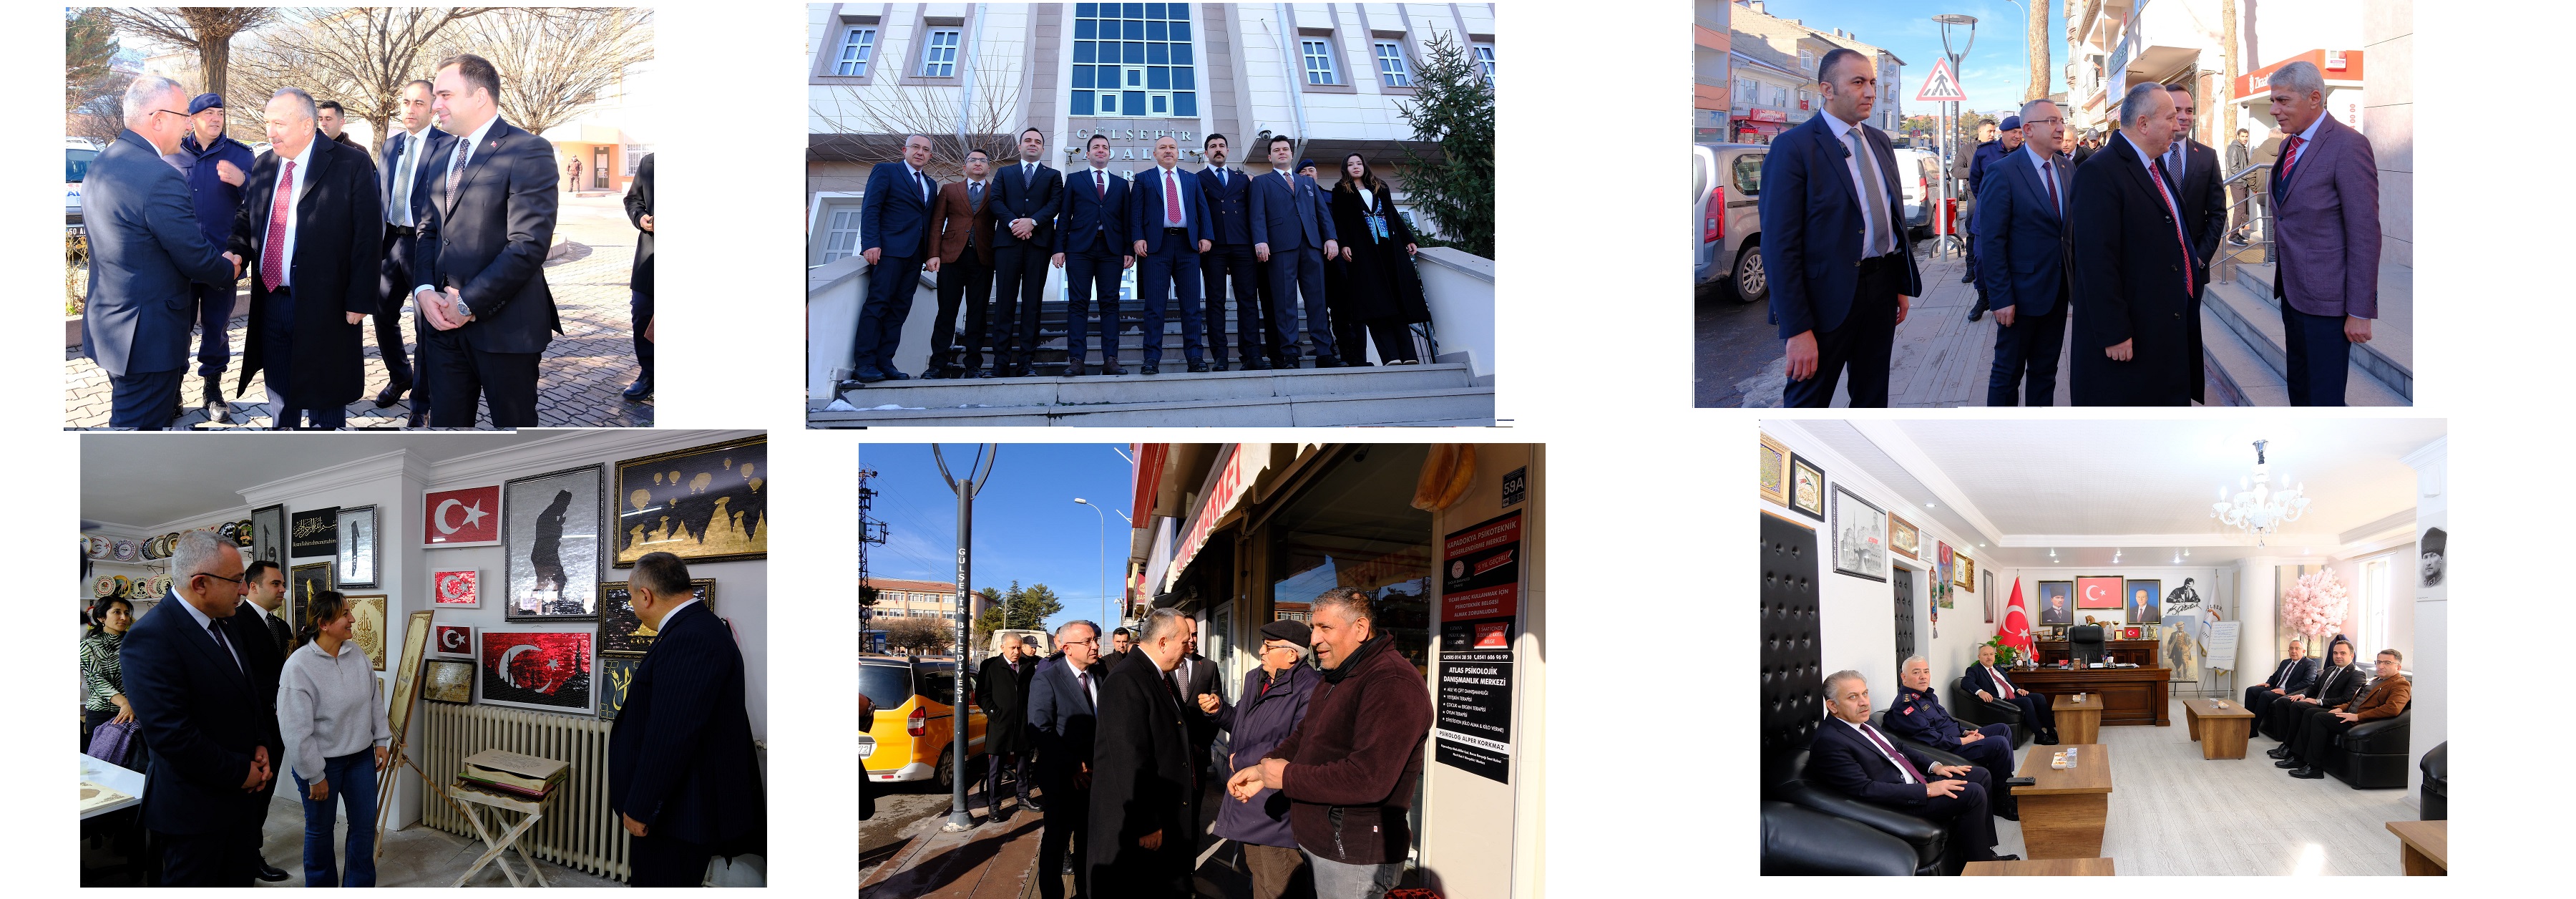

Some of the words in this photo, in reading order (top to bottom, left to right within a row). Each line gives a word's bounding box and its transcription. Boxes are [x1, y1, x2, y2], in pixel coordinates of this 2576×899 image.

[1197, 443, 1241, 545] MARKET
[1504, 477, 1523, 495] 59A
[1447, 534, 1477, 550] KAPADOKYA
[1478, 520, 1517, 540] PSİKOTEKNİK
[1450, 542, 1485, 557] DEĞERLENDİRME
[1485, 533, 1507, 546] MERKEZİ
[1489, 553, 1508, 565] GEÇERLİ
[957, 548, 966, 614] GÜLŞEHİR
[1471, 591, 1498, 599] KULLANMAK
[1498, 588, 1509, 596] İÇİN
[1455, 601, 1480, 610] PSİKOTEKNİK
[1481, 598, 1499, 606] BELGESİ
[1465, 666, 1498, 675] PSİKOLOJİK
[1443, 676, 1479, 684] DANIŞMANLIK
[1480, 677, 1506, 686] MERKEZİ
[1439, 731, 1461, 740] PSİKOLOG
[1478, 739, 1504, 751] KORKMAZ
